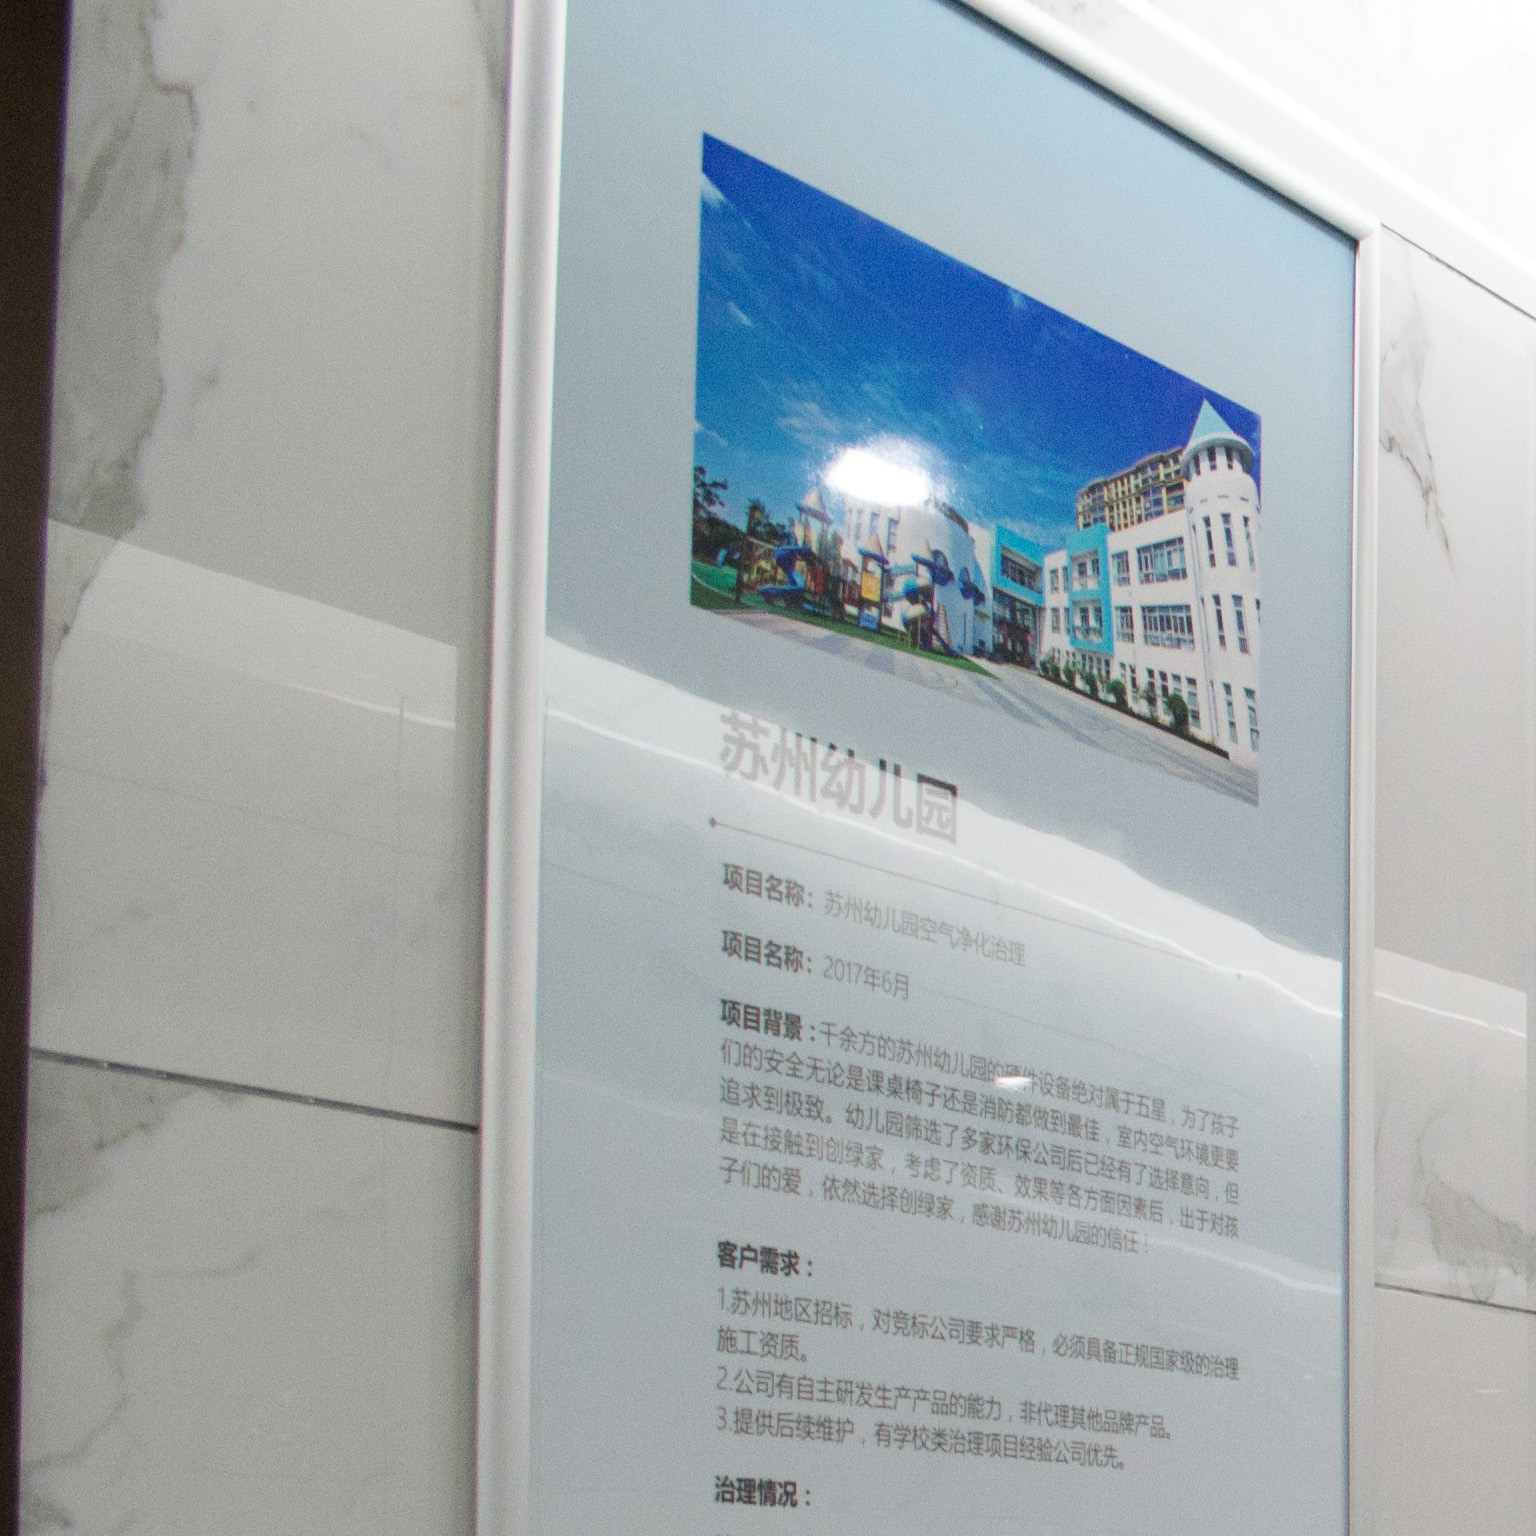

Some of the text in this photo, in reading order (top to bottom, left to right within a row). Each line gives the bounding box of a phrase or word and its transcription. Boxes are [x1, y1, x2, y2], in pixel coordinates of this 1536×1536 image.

[720, 709, 958, 845] 苏州幼儿园
[717, 1325, 808, 1363] 施工资质。
